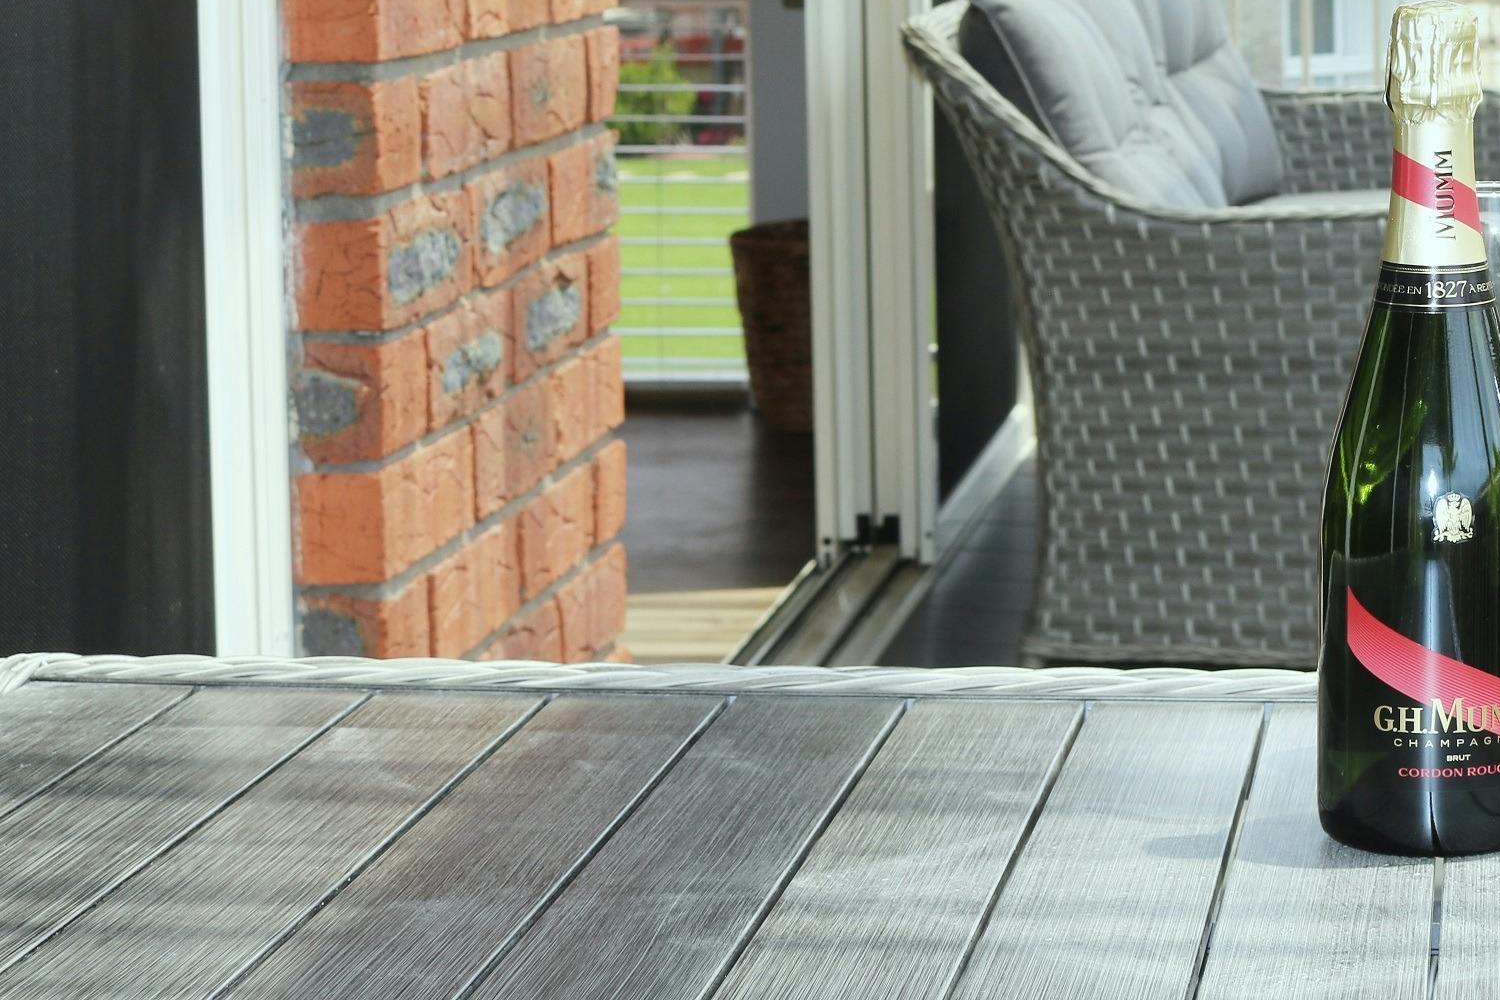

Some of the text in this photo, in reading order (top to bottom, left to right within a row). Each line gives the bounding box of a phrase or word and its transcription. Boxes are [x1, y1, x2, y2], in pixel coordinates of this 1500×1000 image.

[1433, 149, 1456, 241] MUMM
[1406, 285, 1422, 295] EN
[1424, 280, 1467, 299] 1827
[1446, 754, 1471, 762] BRUT
[1398, 767, 1463, 778] CORDON
